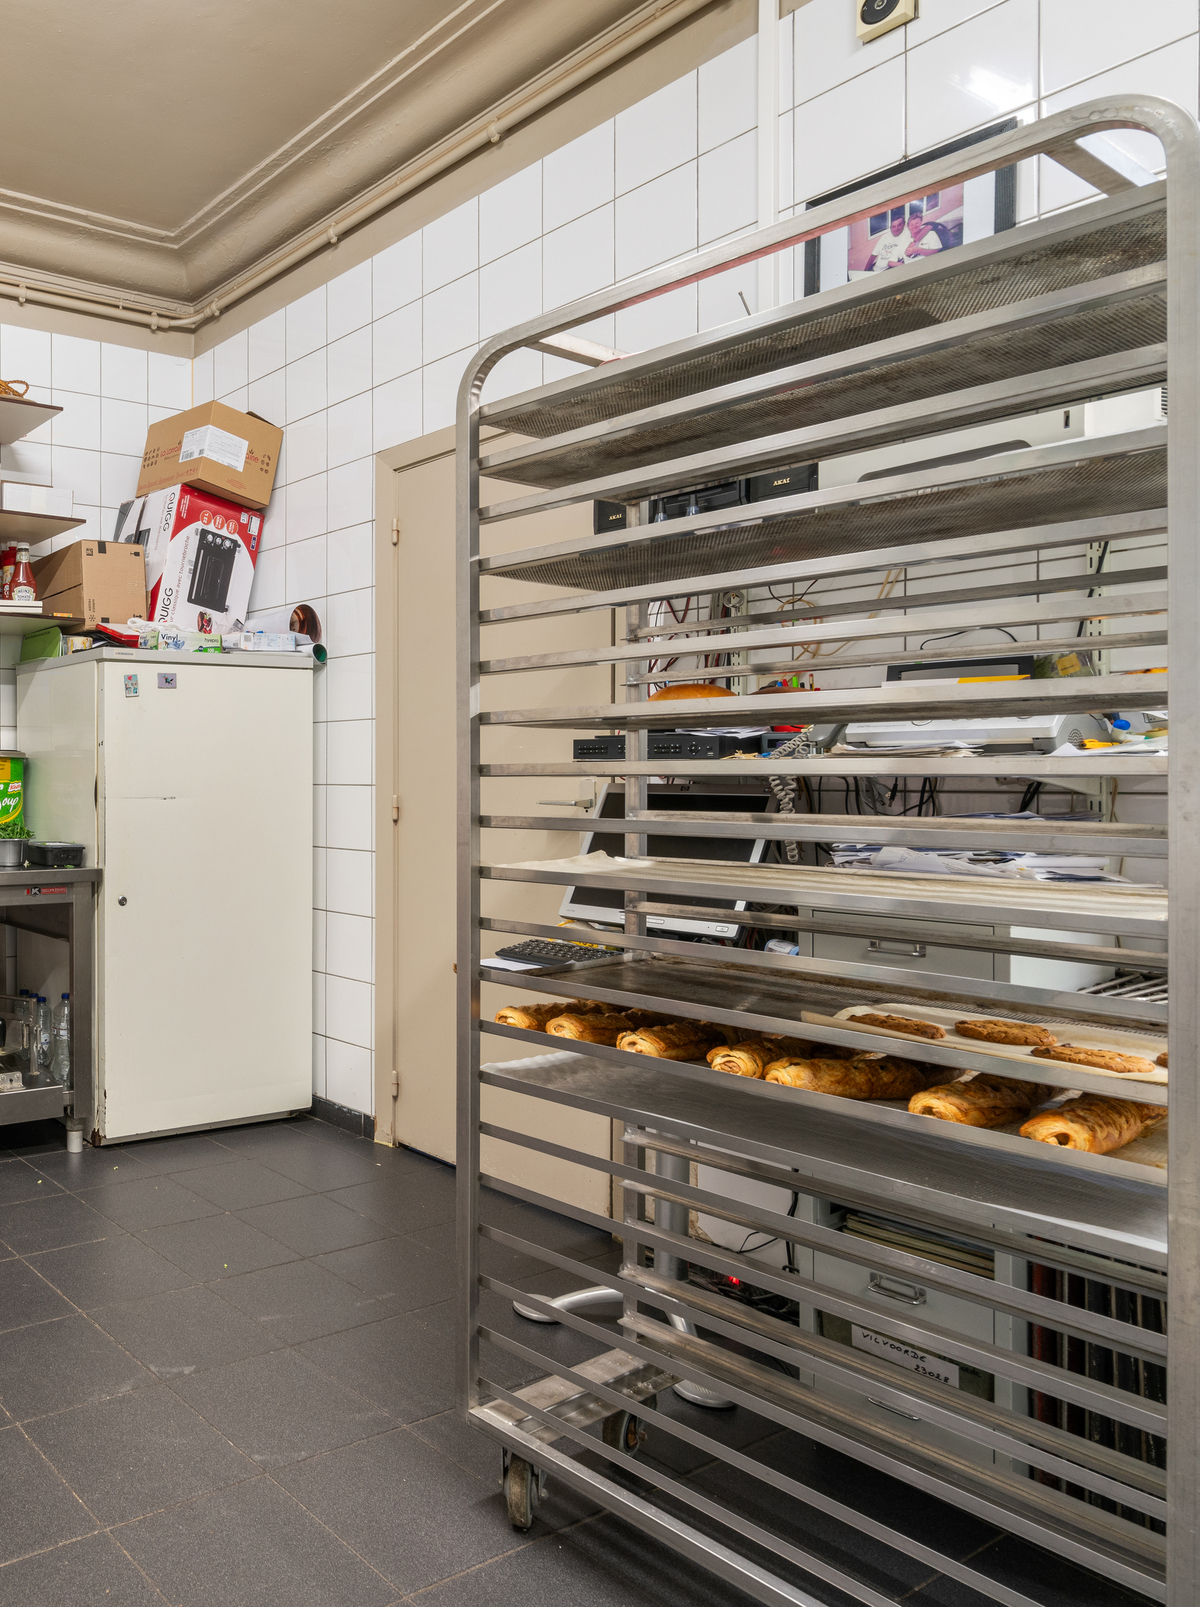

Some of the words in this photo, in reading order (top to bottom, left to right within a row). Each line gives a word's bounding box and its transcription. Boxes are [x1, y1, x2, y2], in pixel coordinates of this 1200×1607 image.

[773, 477, 791, 486] AKAI
[163, 492, 175, 532] QUIGG
[171, 589, 180, 616] classique
[179, 536, 190, 574] tournebroche
[158, 587, 173, 622] QUIGG
[161, 634, 178, 642] Vinyl
[862, 1332, 927, 1362] VILVOORDE
[914, 1364, 950, 1383] 23028
